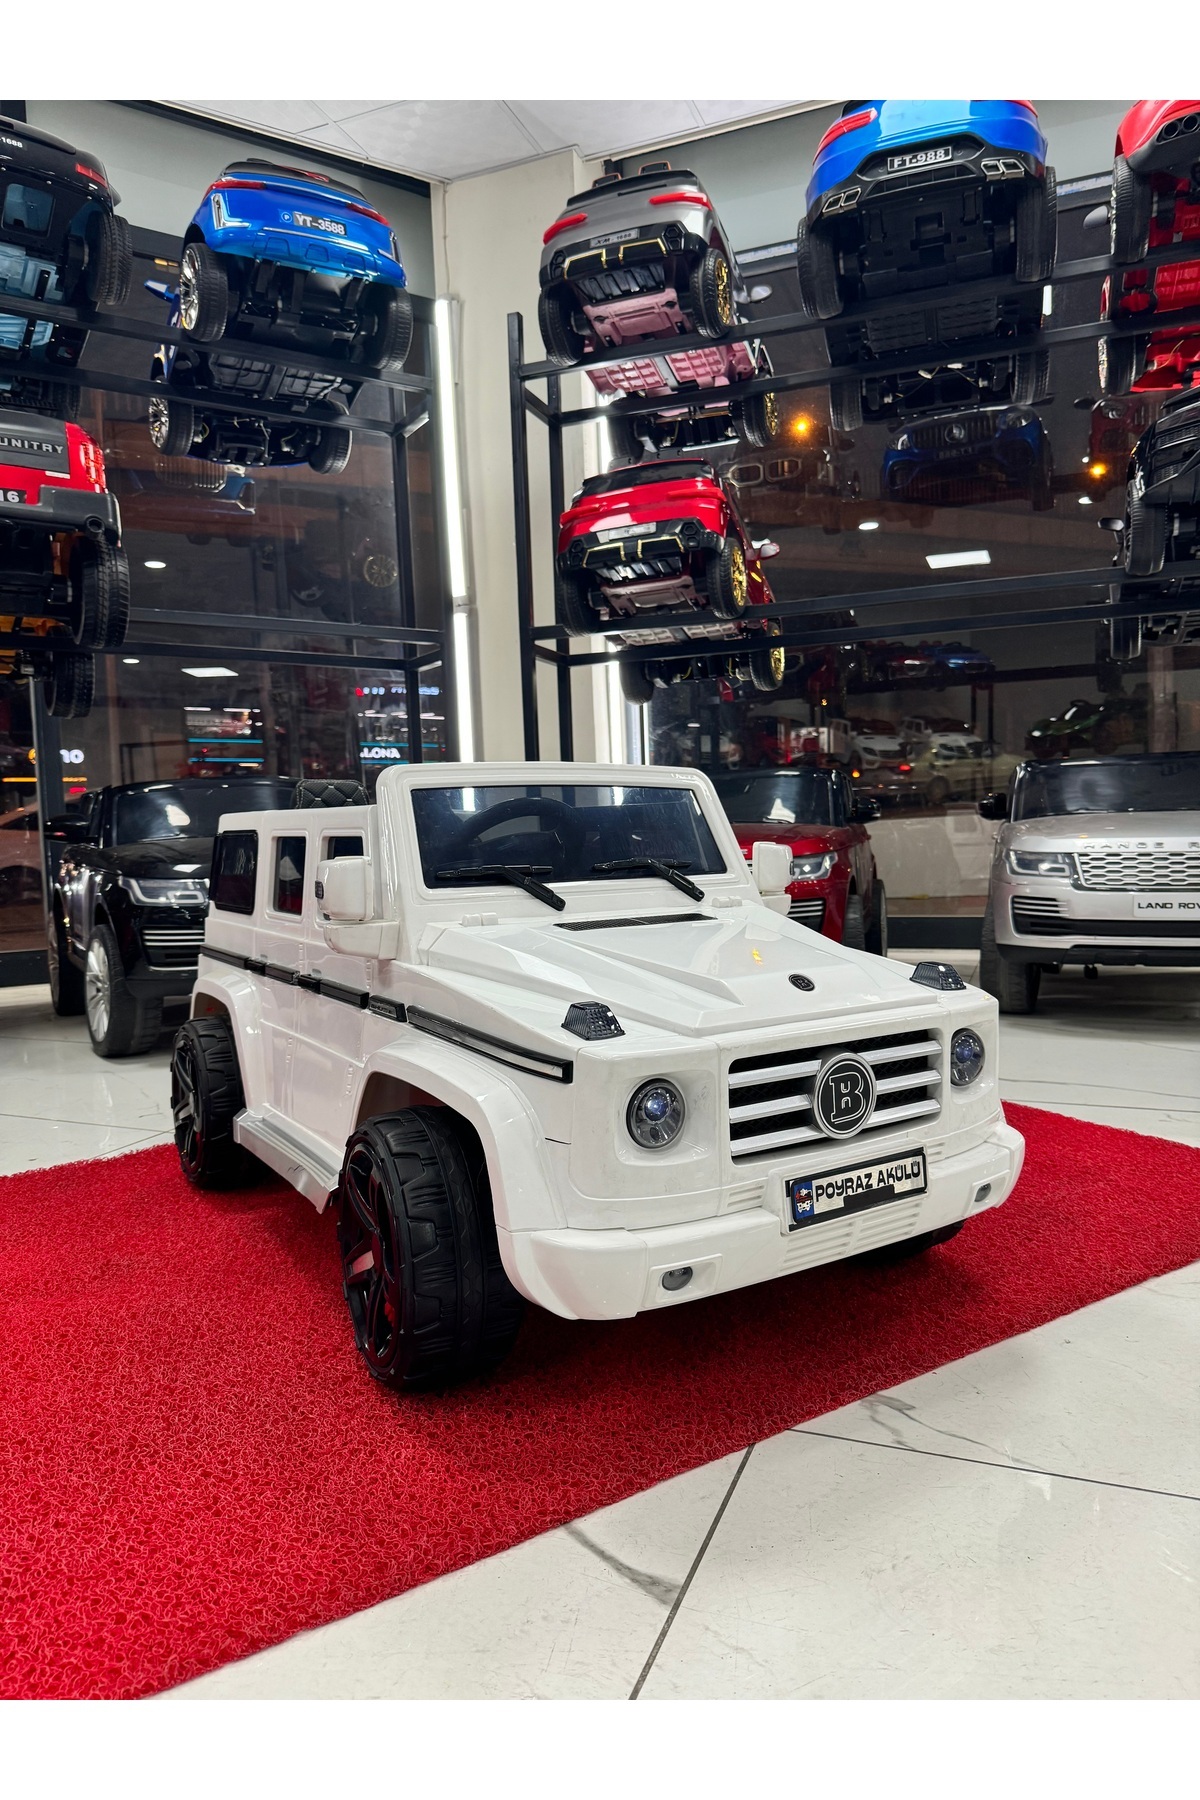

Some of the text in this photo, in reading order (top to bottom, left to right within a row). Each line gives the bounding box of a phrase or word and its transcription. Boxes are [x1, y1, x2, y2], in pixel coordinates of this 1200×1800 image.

[893, 149, 945, 168] FT-988
[295, 213, 346, 235] YT-3588
[1137, 902, 1174, 910] LAND
[815, 1172, 874, 1203] POYRAZ
